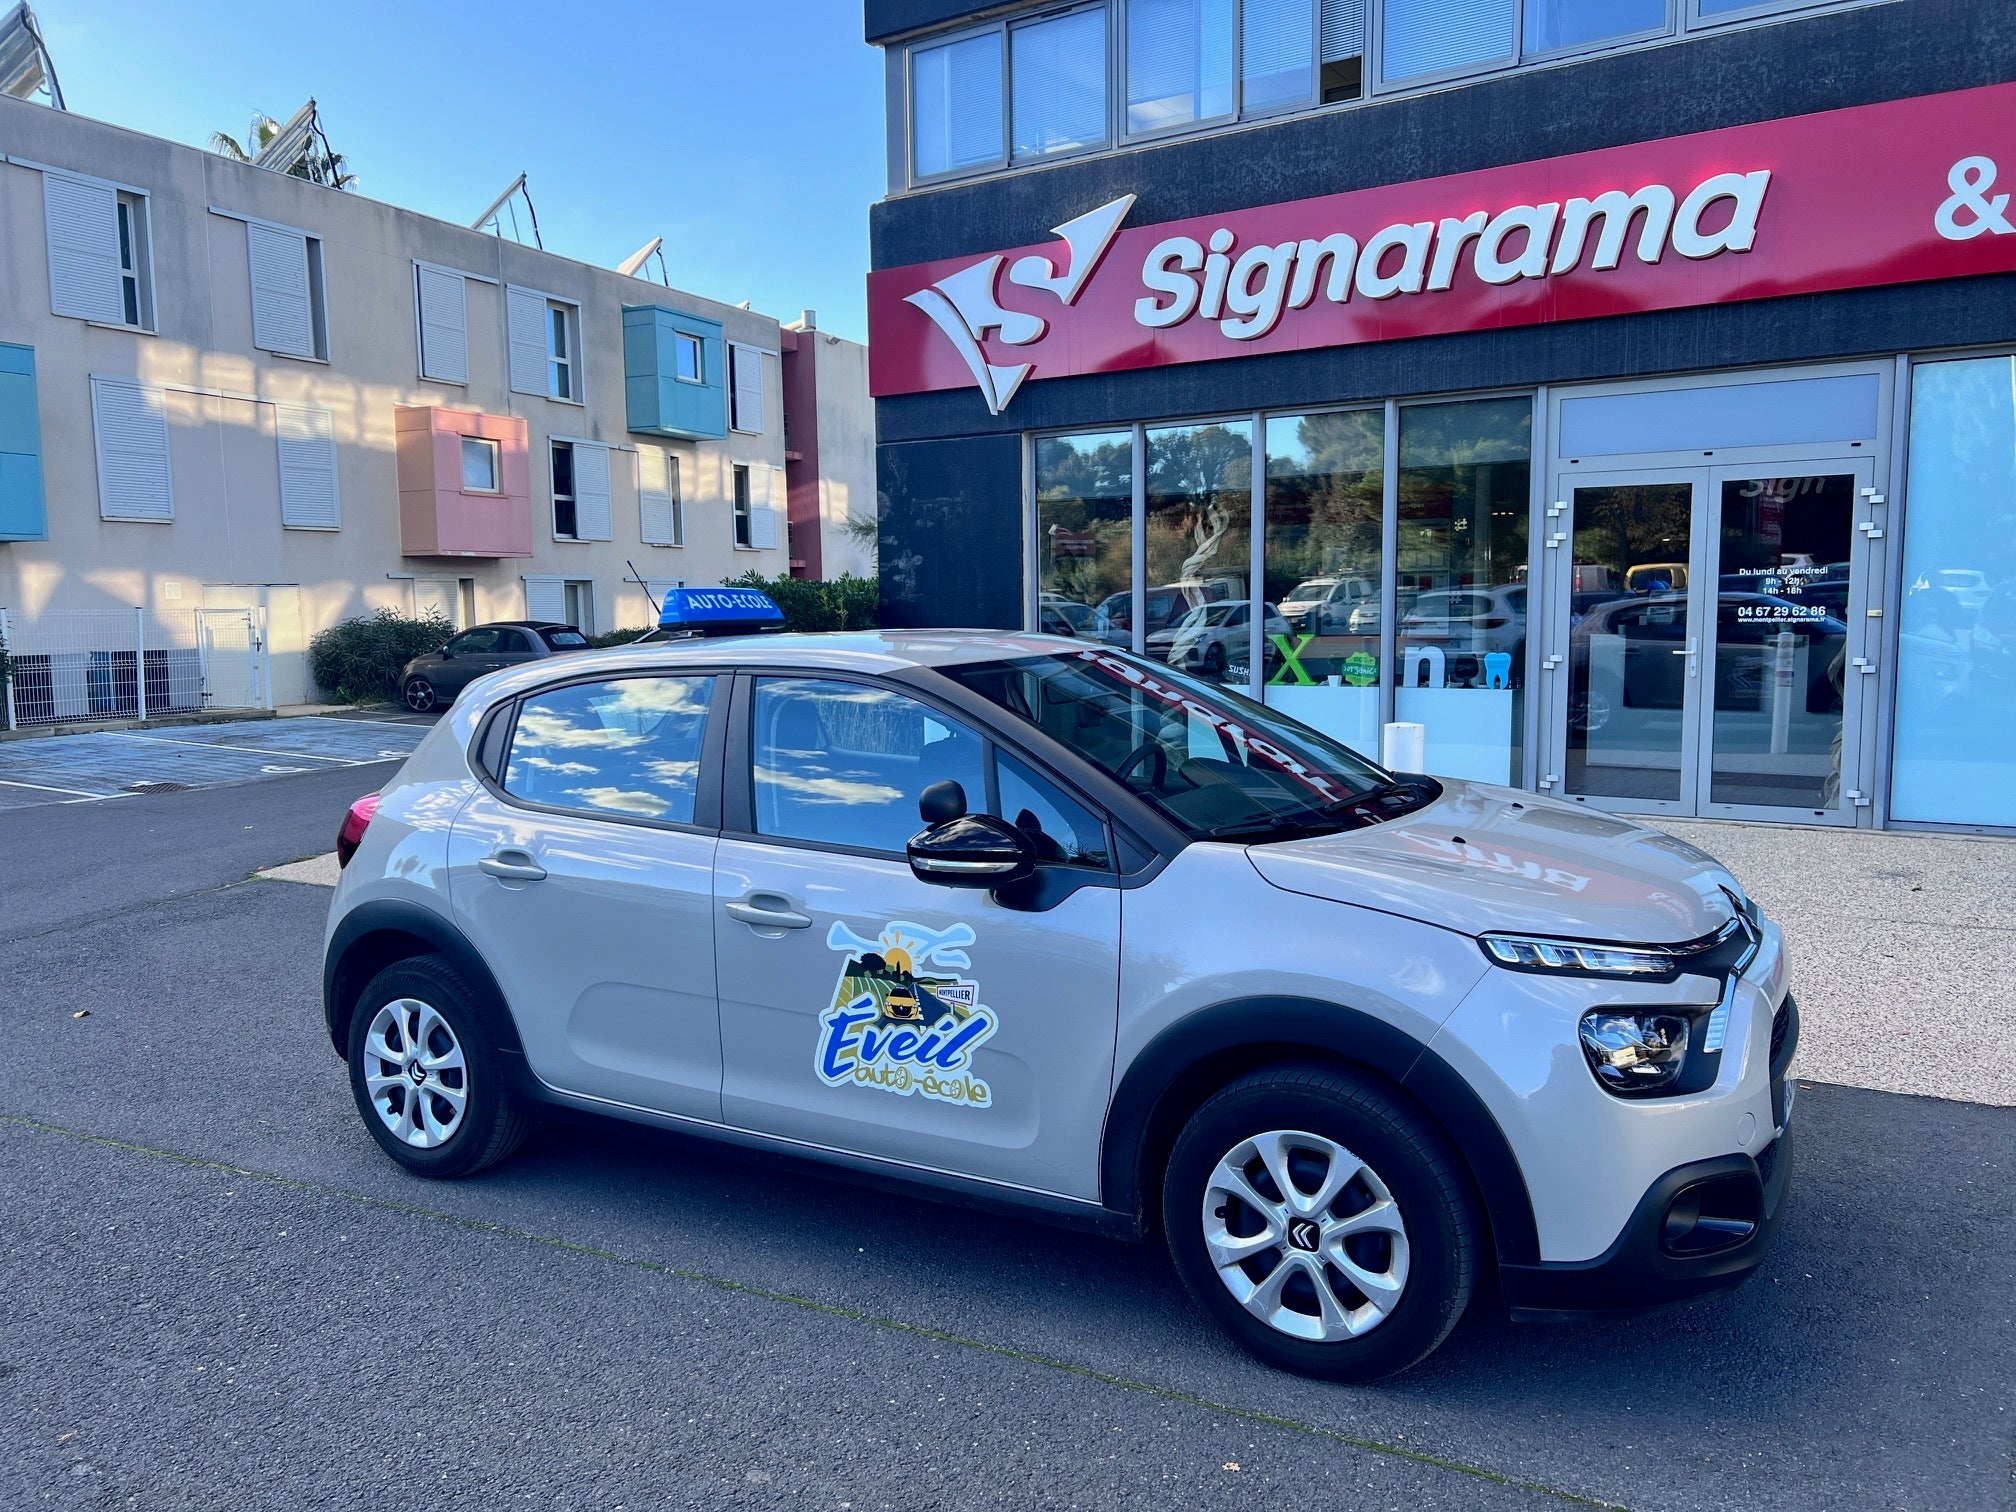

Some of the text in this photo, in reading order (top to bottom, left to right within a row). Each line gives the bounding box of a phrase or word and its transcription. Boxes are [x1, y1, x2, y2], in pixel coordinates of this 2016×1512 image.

[1134, 155, 2016, 341] Signarama &
[1739, 568, 1751, 576] Du
[1753, 567, 1775, 576] lundi
[1789, 567, 1828, 575] vendredi
[1765, 577, 1776, 585] 9h
[1762, 587, 1779, 595] 14h
[1786, 586, 1802, 595] 18h
[687, 594, 773, 610] AUTO-ECOLE
[1738, 606, 1826, 616] 04 67 29 62 86
[823, 997, 988, 1079] Éveil
